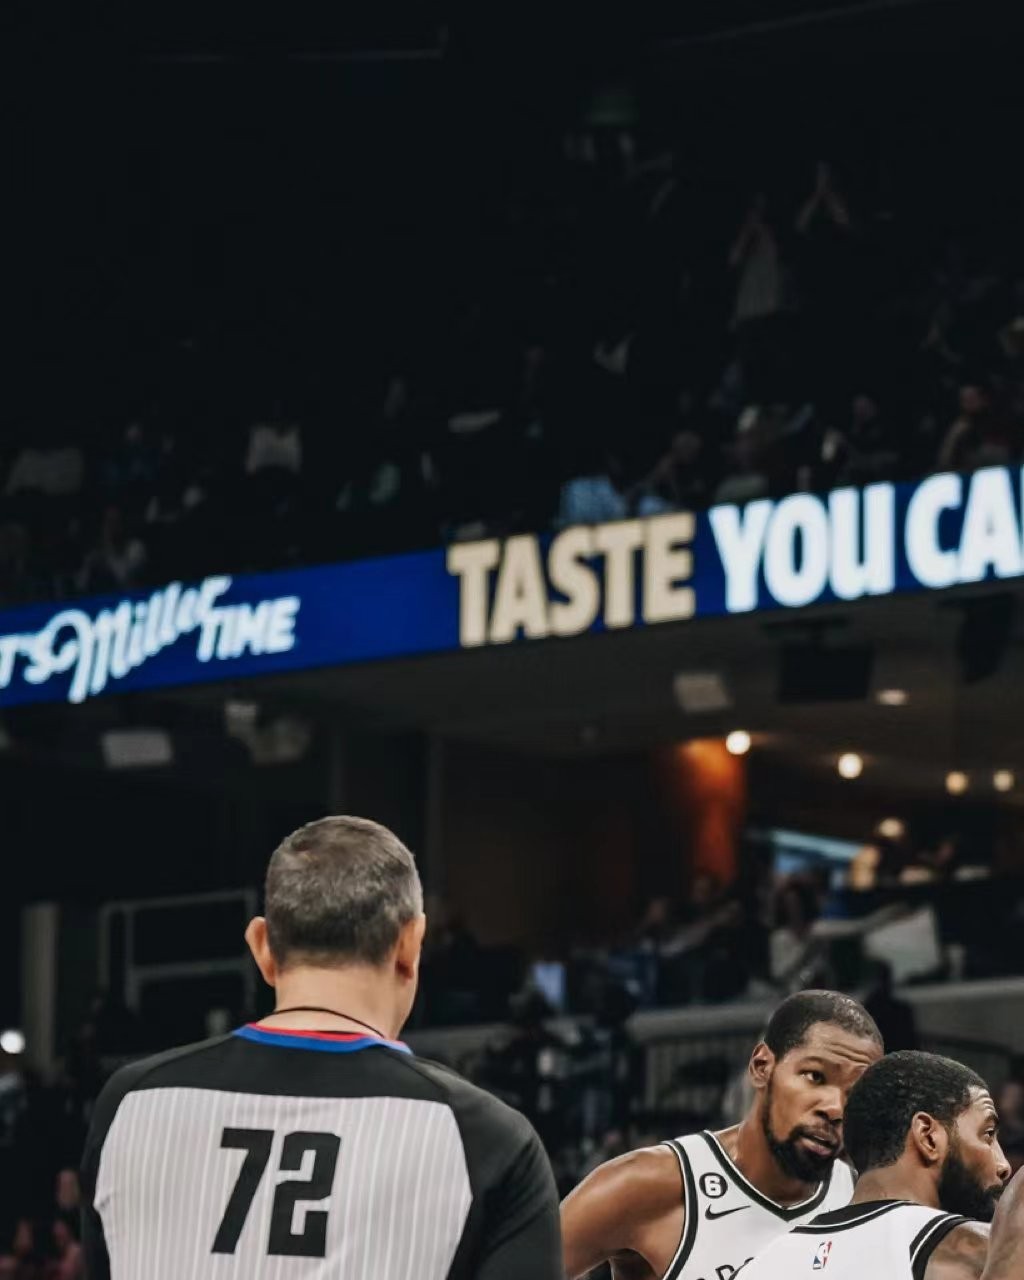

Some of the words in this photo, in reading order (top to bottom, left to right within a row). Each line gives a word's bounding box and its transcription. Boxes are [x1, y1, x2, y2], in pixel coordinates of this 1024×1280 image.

[446, 511, 697, 648] TASTE
[708, 482, 896, 613] YOU
[46, 574, 232, 703] Miller
[197, 595, 300, 662] TIME
[210, 1126, 341, 1258] 72
[703, 1174, 723, 1197] 6
